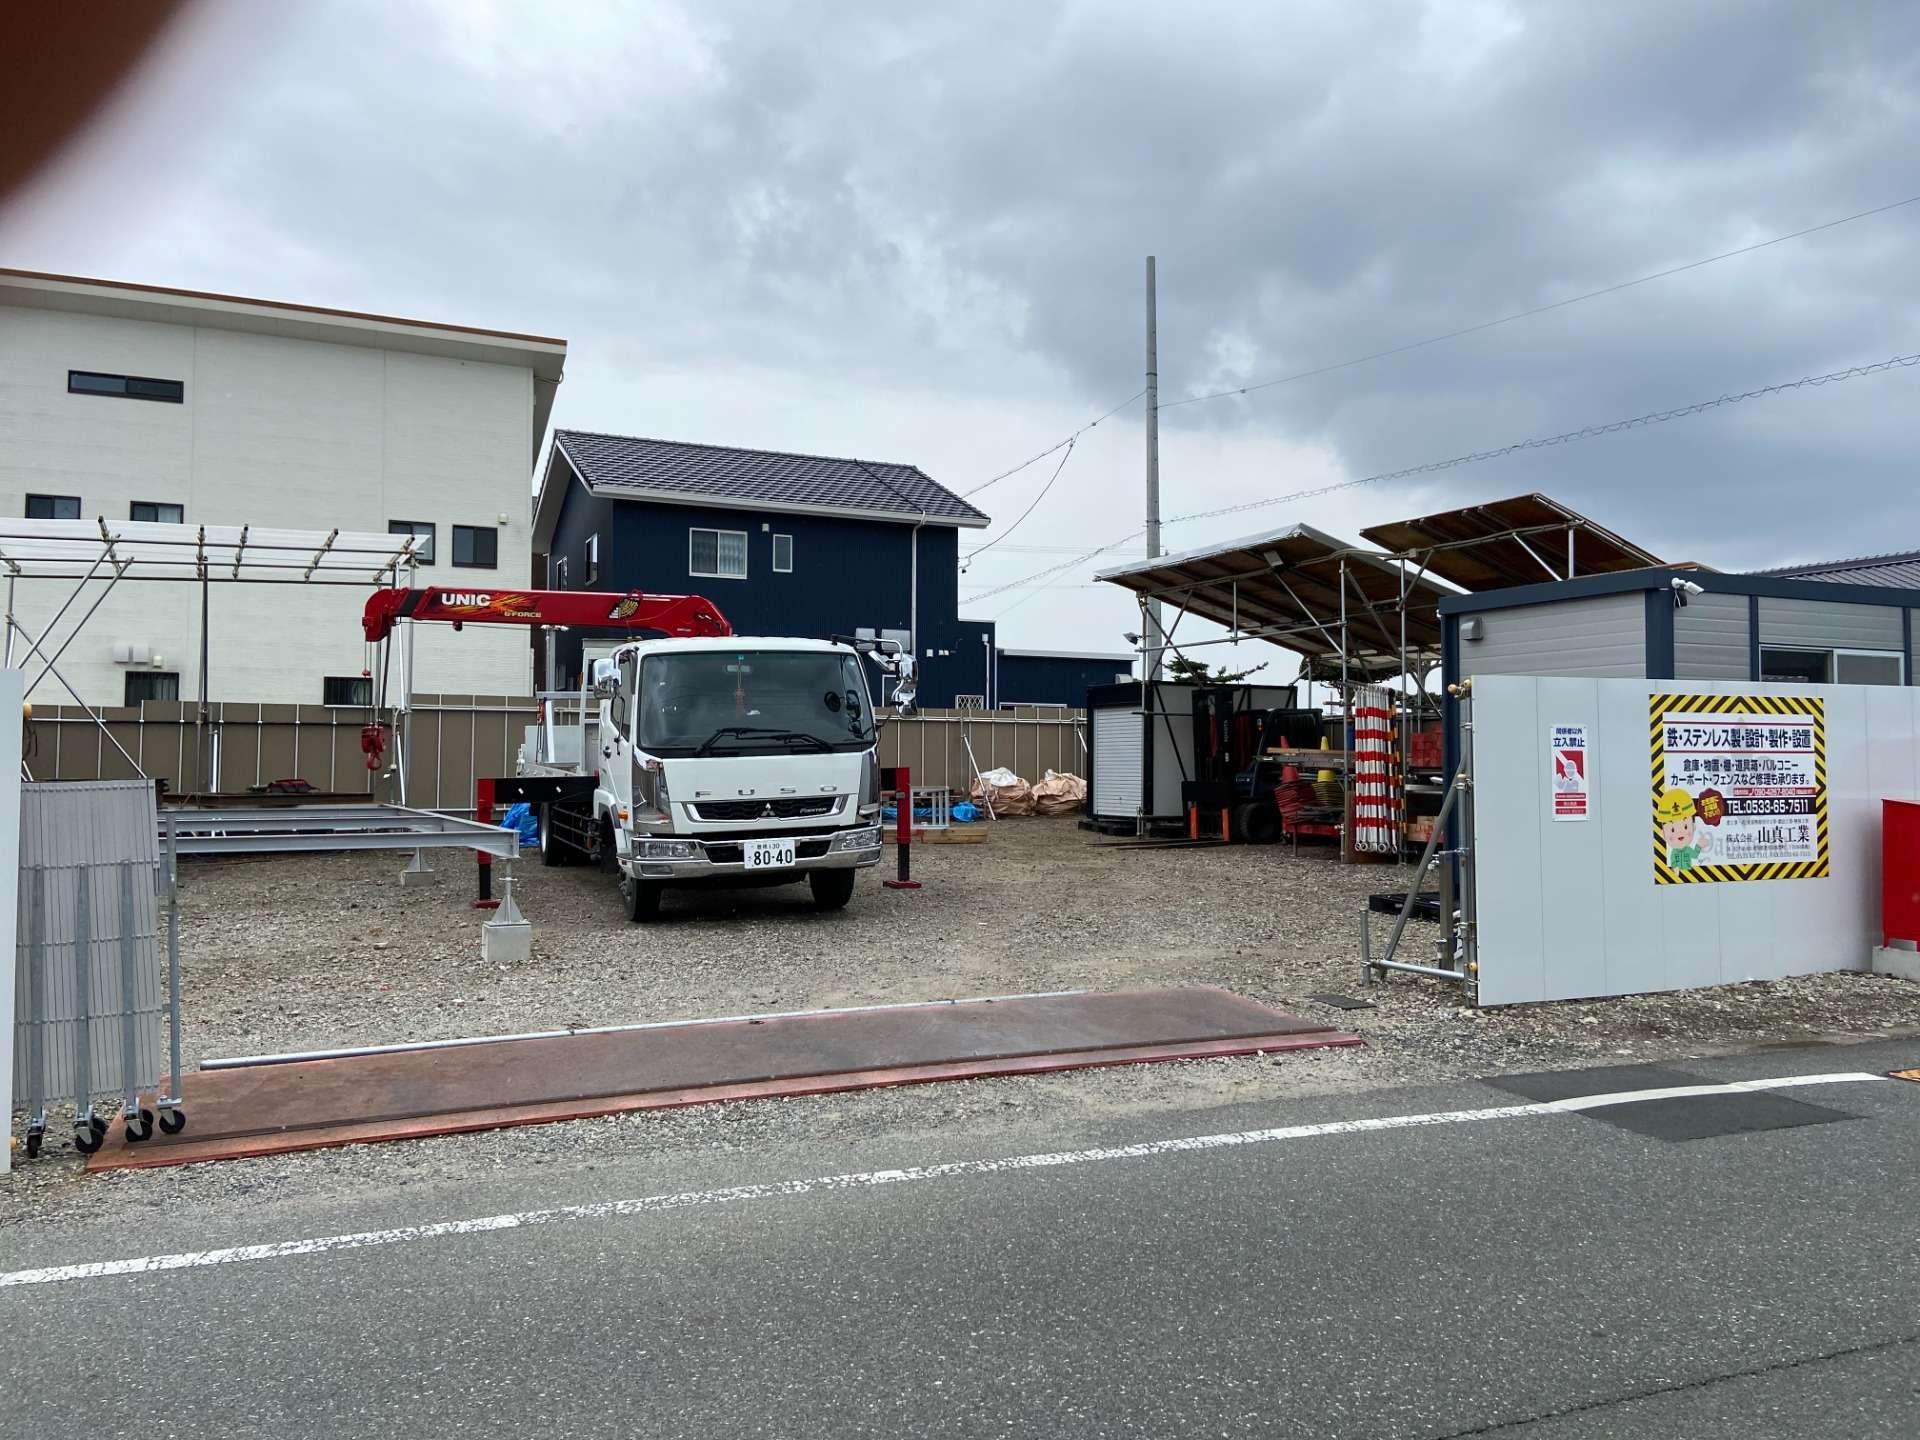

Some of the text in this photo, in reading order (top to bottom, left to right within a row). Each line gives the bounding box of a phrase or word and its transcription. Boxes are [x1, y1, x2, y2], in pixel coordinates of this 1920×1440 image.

[441, 592, 491, 607] UNIC
[1553, 737, 1585, 747] 立入禁止
[695, 785, 838, 798] FUSO
[1757, 826, 1810, 844] 山真工業
